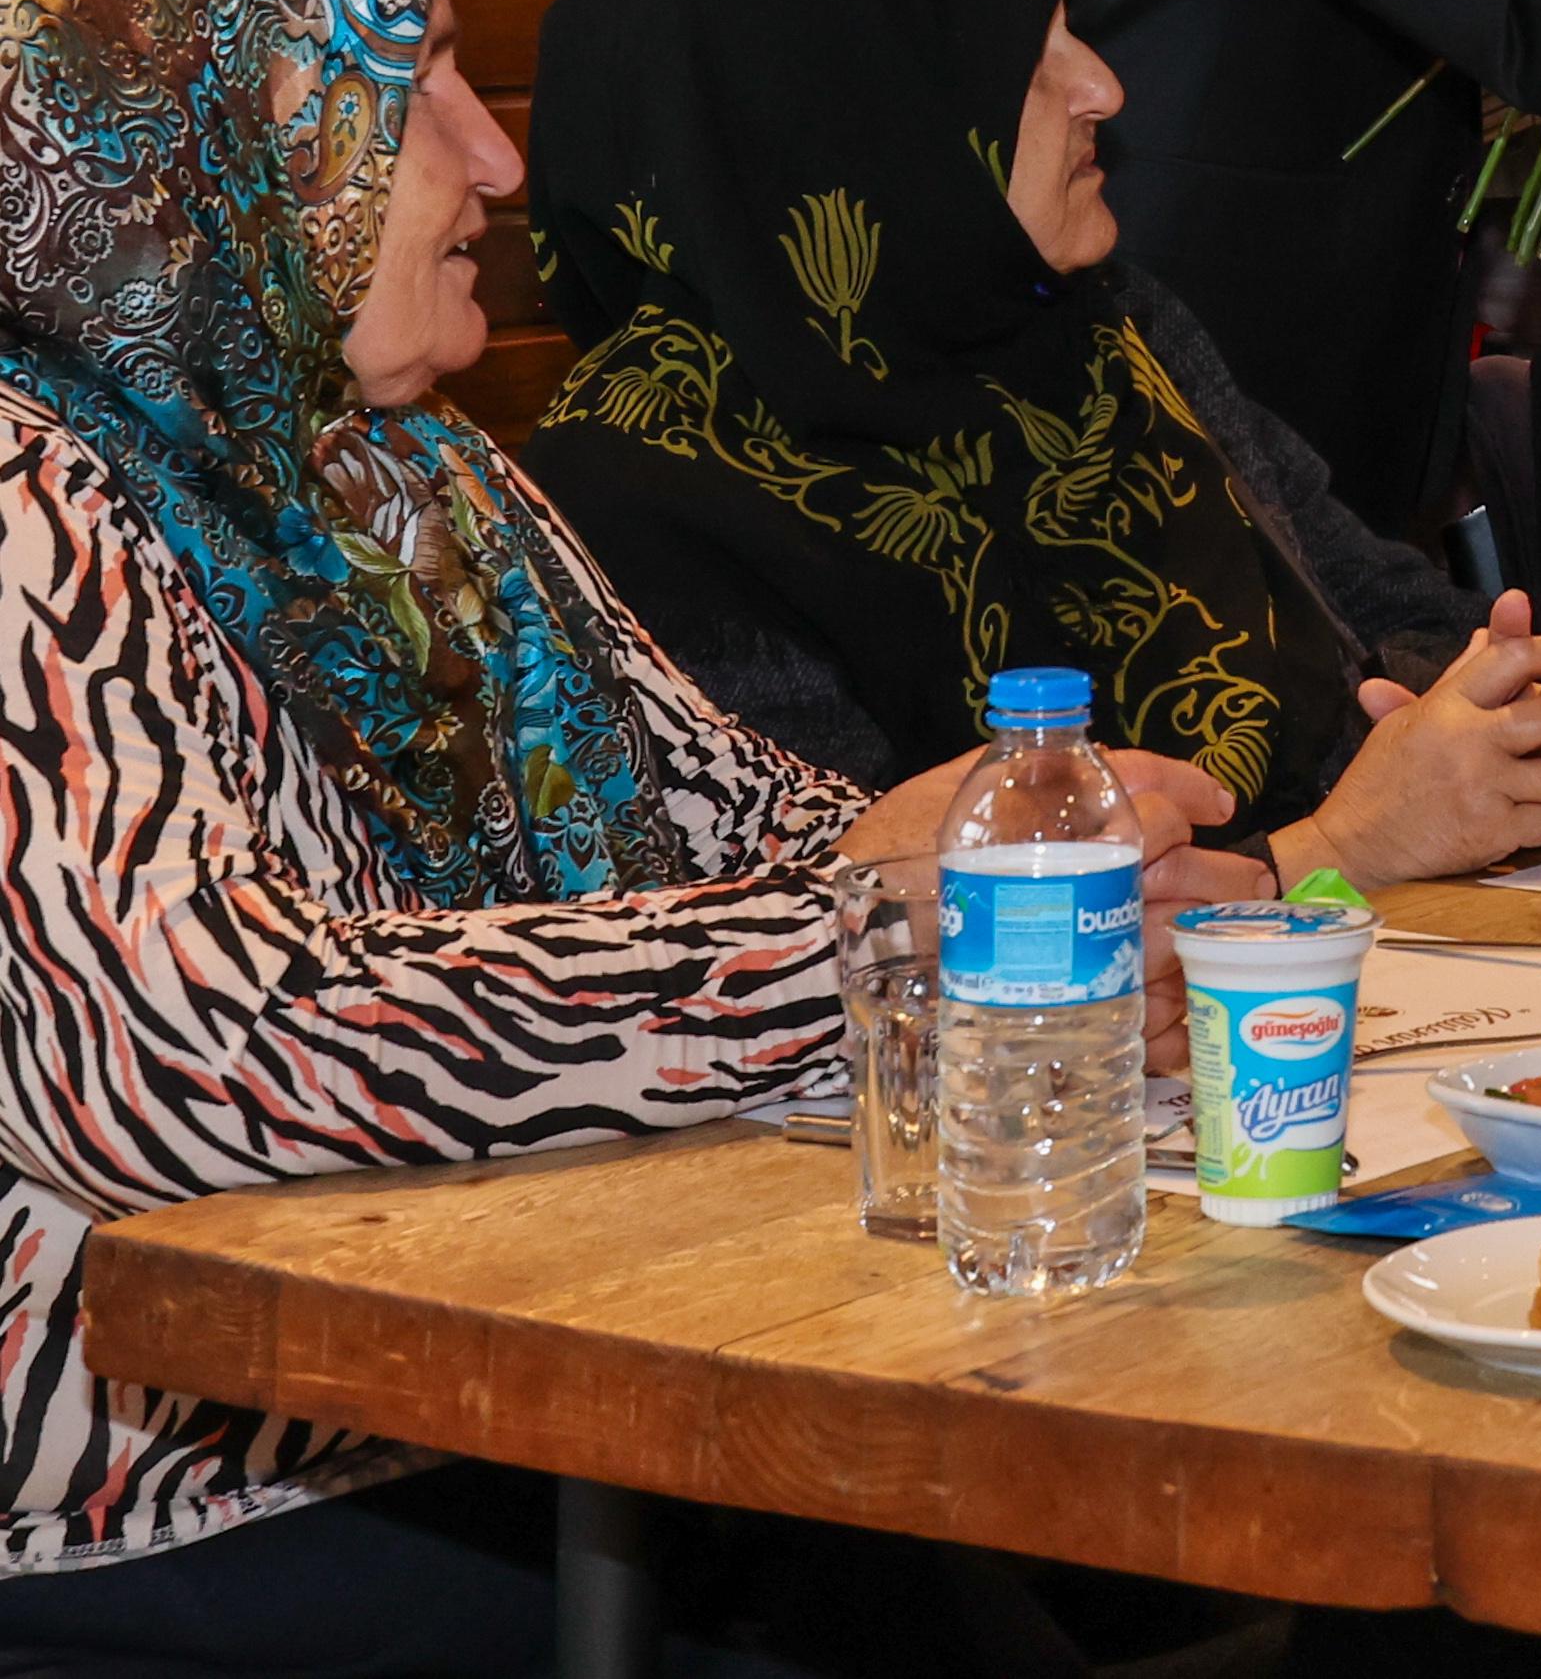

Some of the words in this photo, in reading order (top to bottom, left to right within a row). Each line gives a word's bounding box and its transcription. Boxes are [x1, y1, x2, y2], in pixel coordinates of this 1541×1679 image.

[1077, 898, 1142, 935] buzda
[1252, 1014, 1339, 1041] güneşoğlu
[1240, 1074, 1340, 1141] Ayran
